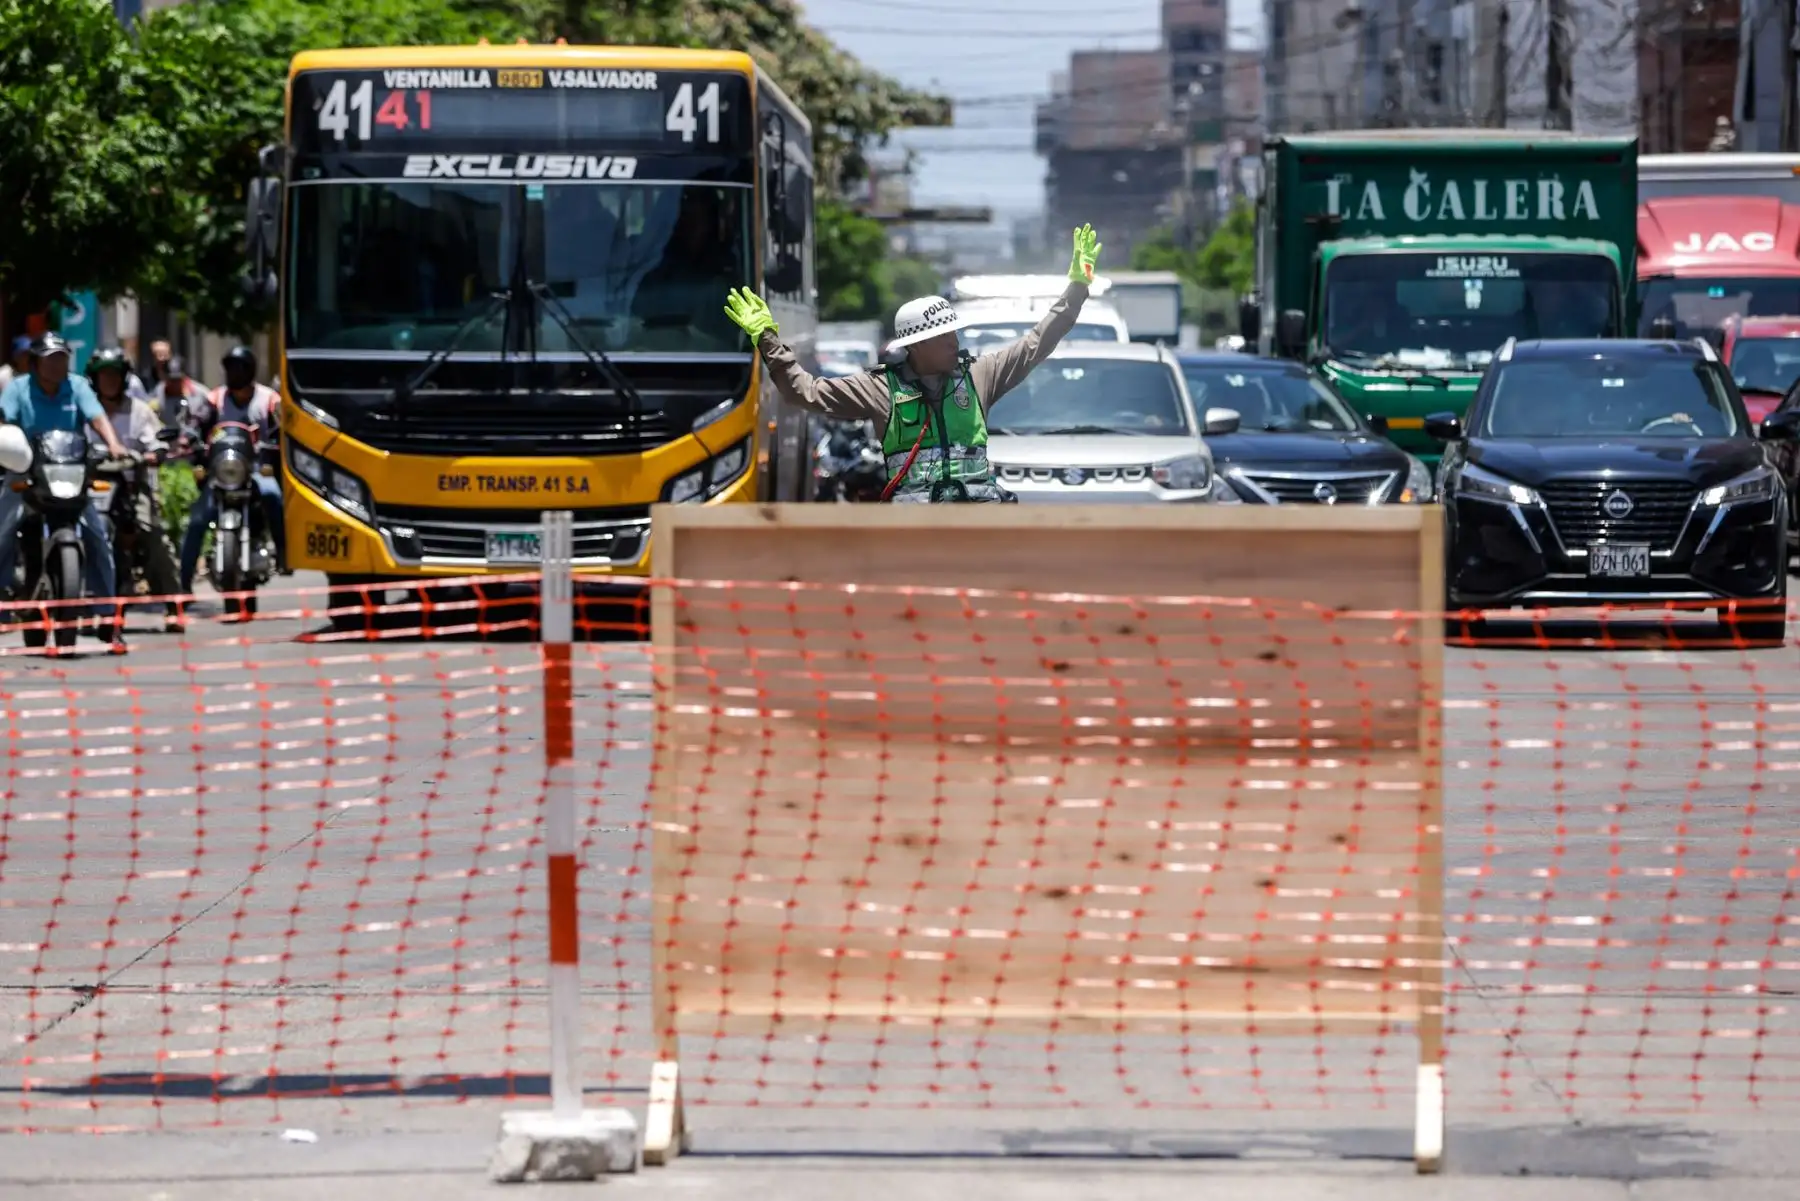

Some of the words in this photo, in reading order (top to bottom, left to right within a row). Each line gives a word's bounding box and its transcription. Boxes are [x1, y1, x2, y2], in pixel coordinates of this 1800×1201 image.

[383, 70, 491, 88] VENTANILLA
[548, 70, 658, 89] V.SALVADOR
[318, 79, 373, 140] 41
[376, 90, 431, 129] 41
[666, 82, 720, 142] 41
[1326, 180, 1386, 220] LA
[1403, 180, 1600, 221] CALERA
[1673, 232, 1776, 253] JAC
[1437, 256, 1508, 271] ISUZU
[438, 474, 472, 491] EMP.
[477, 475, 538, 492] TRANSP.
[544, 477, 560, 492] 41
[307, 532, 349, 557] 9801
[1592, 554, 1646, 572] BZN-061
